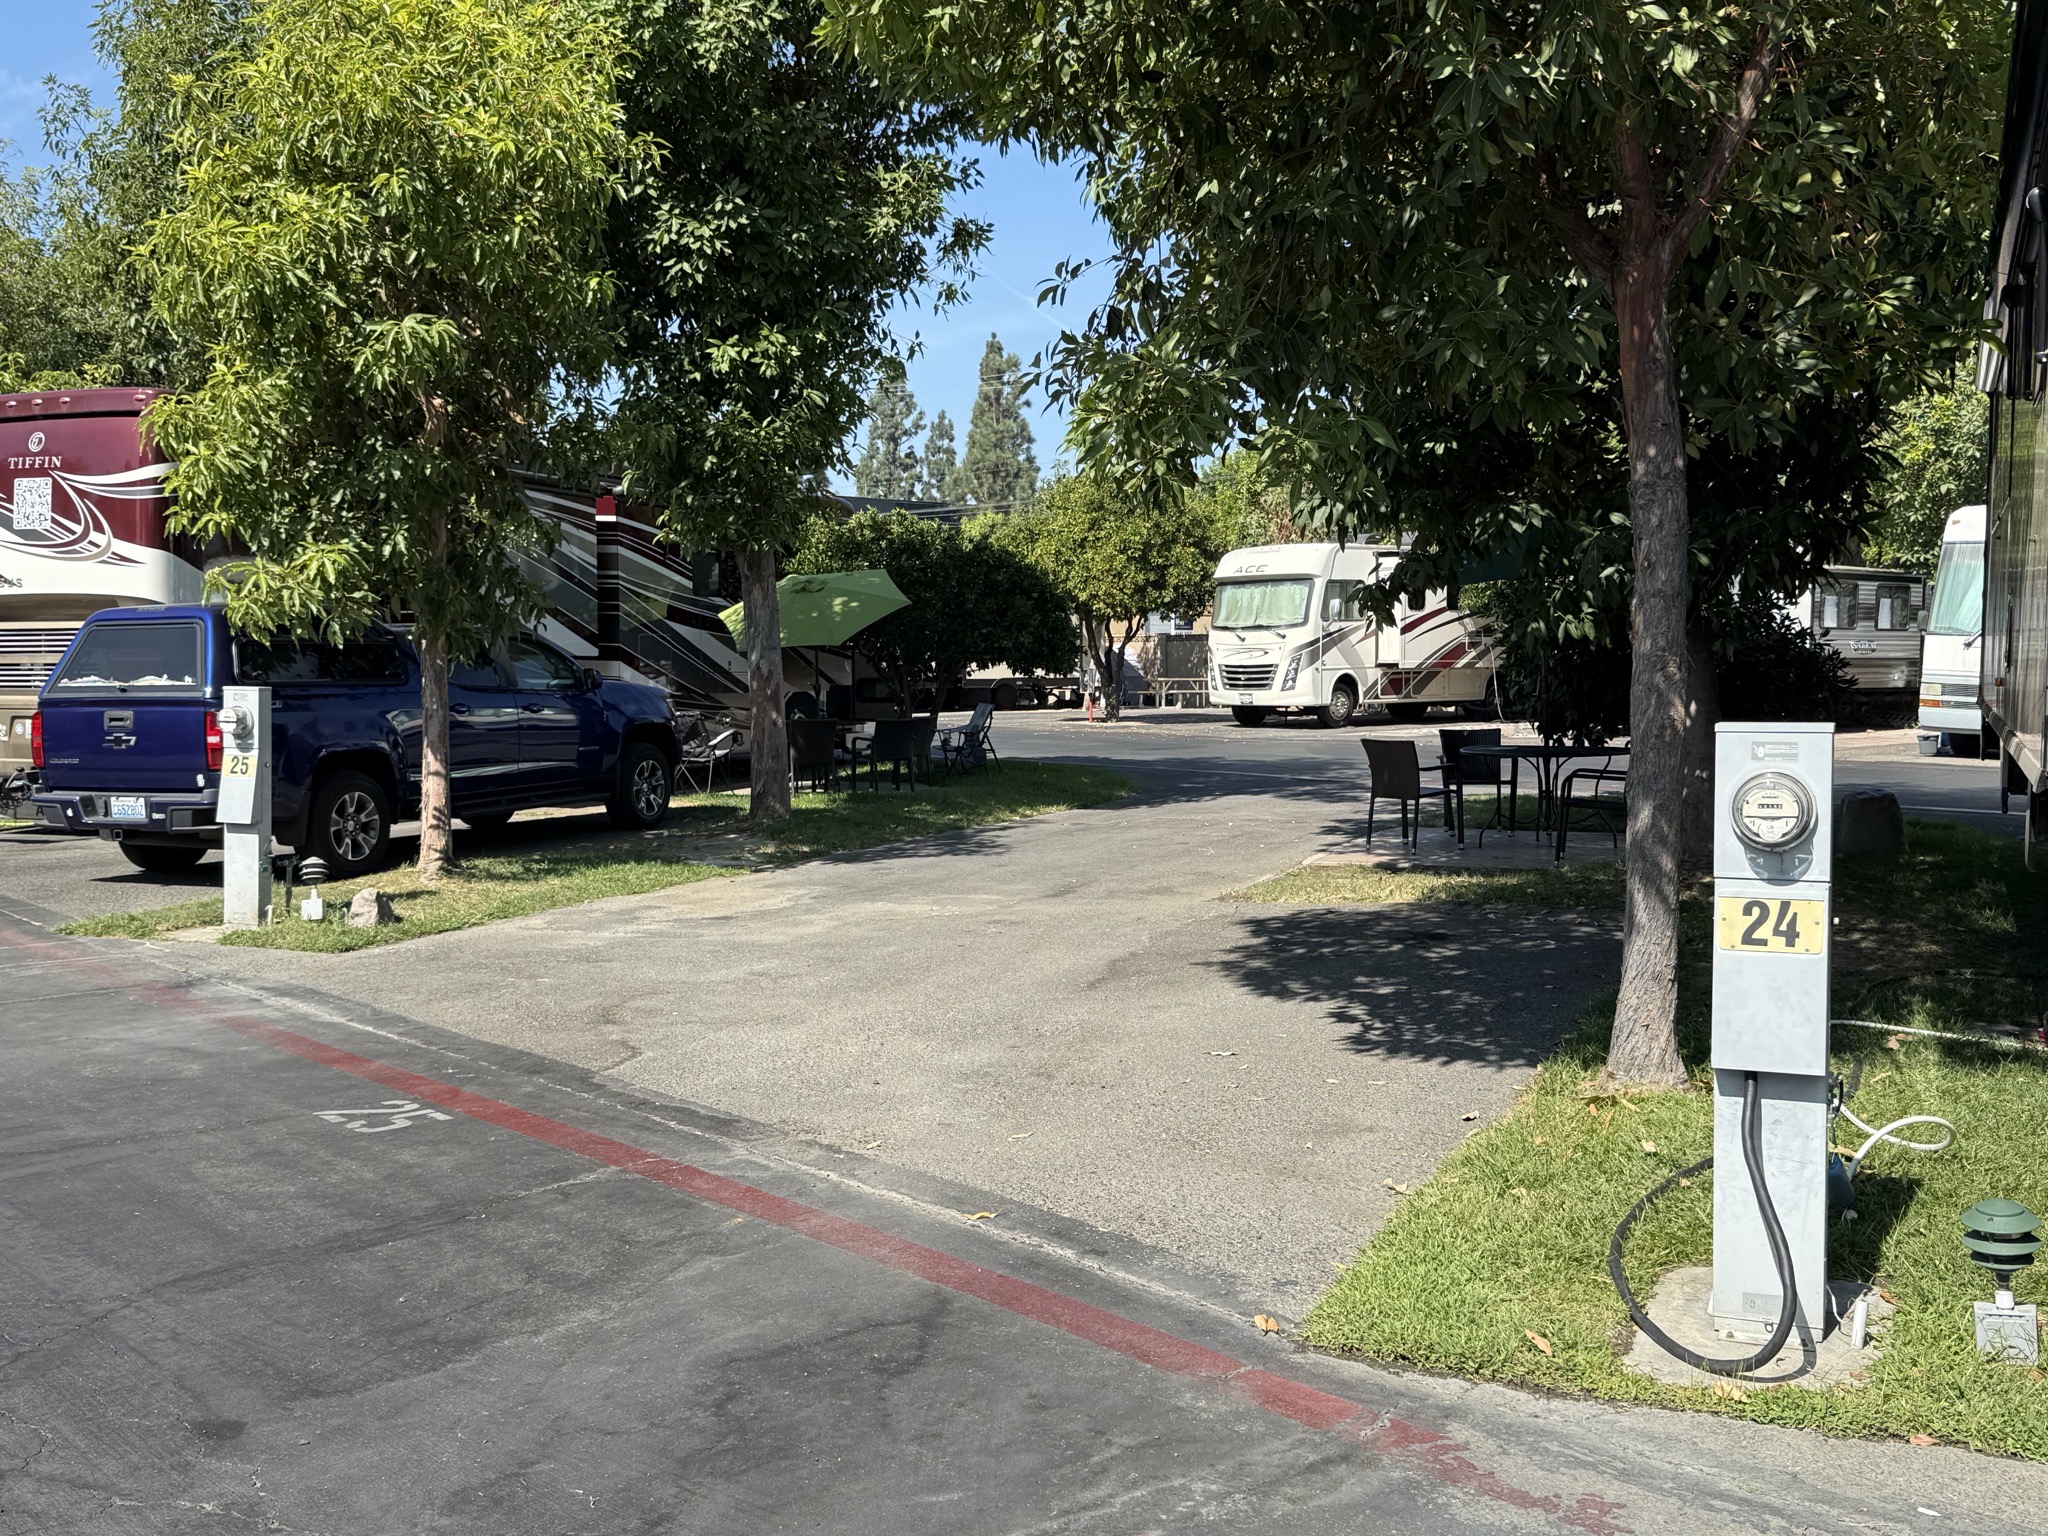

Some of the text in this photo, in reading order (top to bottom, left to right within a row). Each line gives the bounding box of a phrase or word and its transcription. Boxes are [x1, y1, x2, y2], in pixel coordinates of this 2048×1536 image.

[8, 456, 62, 469] TIFFIN
[1233, 564, 1268, 574] ACE
[230, 756, 249, 775] 25
[1741, 900, 1800, 948] 24
[312, 1100, 454, 1132] 25
